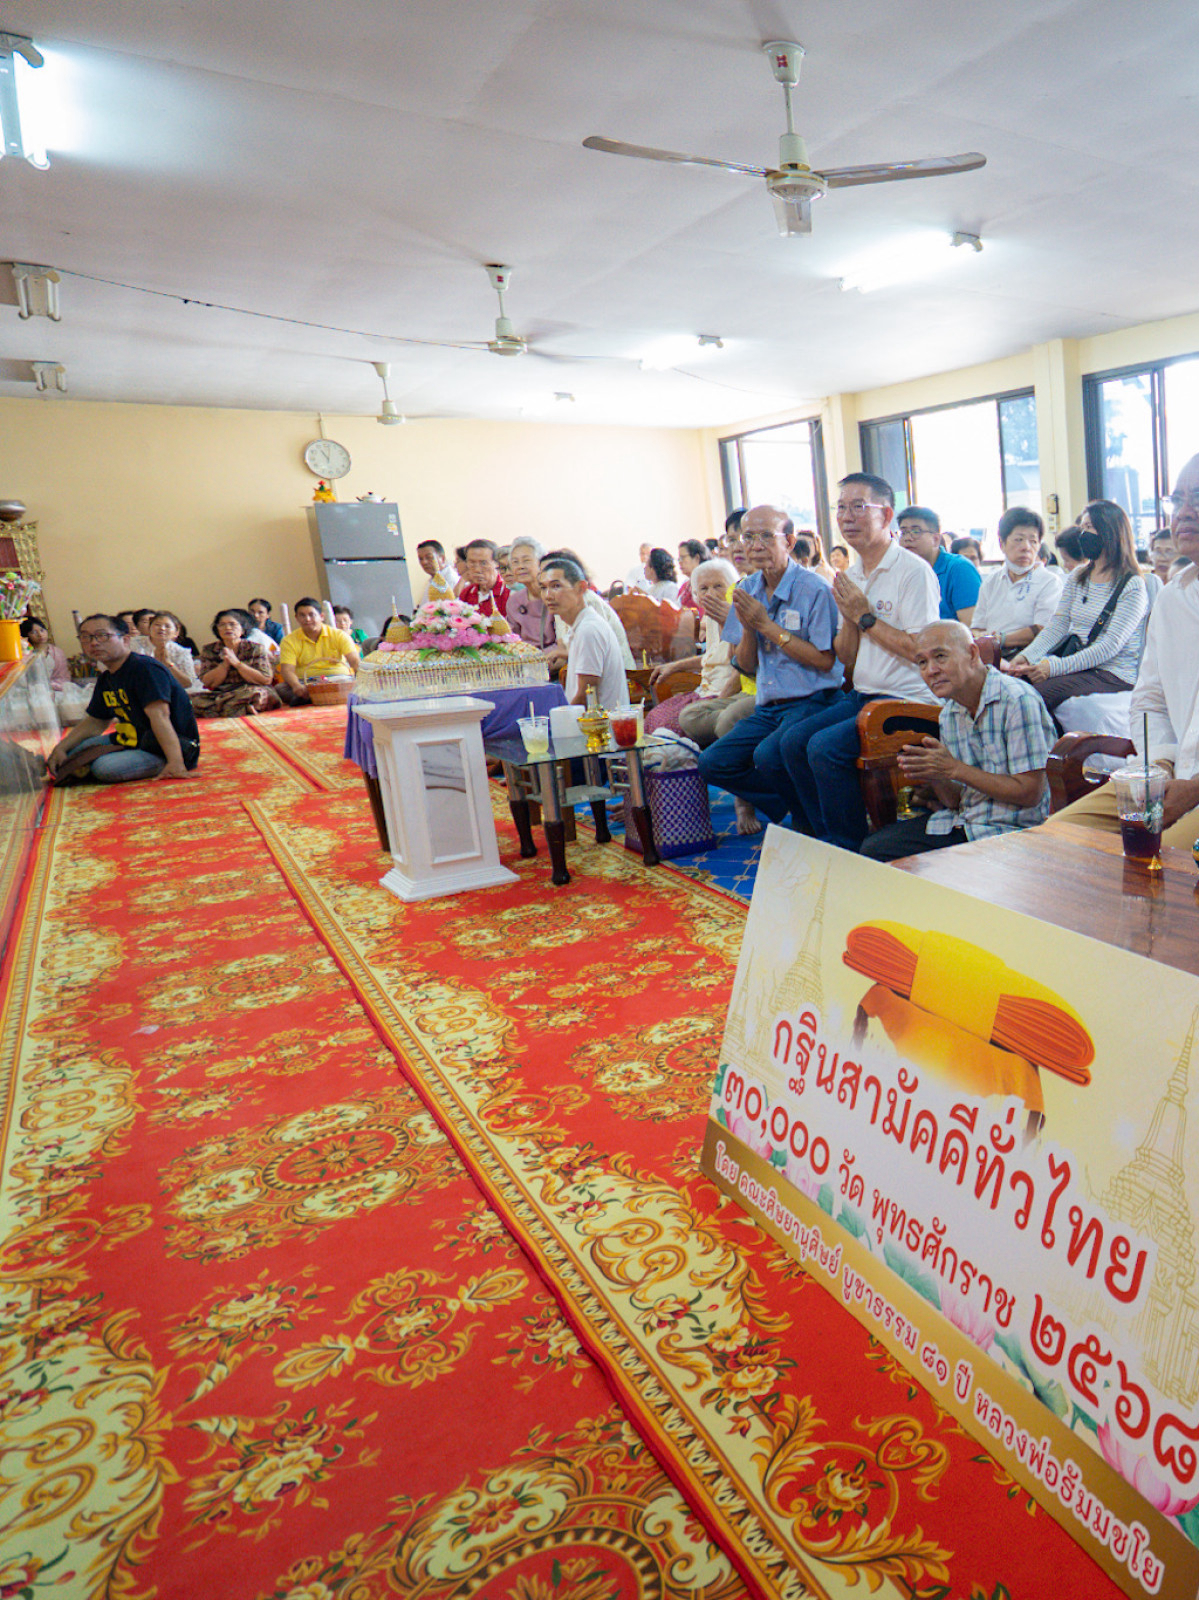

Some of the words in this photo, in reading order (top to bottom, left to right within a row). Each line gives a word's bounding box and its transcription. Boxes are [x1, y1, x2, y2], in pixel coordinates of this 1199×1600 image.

[724, 1070, 831, 1176] ๓๐,๐๐๐
[838, 1148, 865, 1208] วัด
[871, 1188, 1016, 1329] พุทธศักราช
[772, 1010, 1148, 1304] กฐินสามัคคีทั่วไทย
[714, 1142, 740, 1182] โดย
[739, 1173, 842, 1276] คณะศิษยานุศิษย์
[843, 1267, 919, 1351] บูชาธรรม
[921, 1344, 948, 1382] ๘๑
[955, 1364, 972, 1400] ปี
[974, 1391, 1161, 1588] หลวงพ่อธัมมชโย
